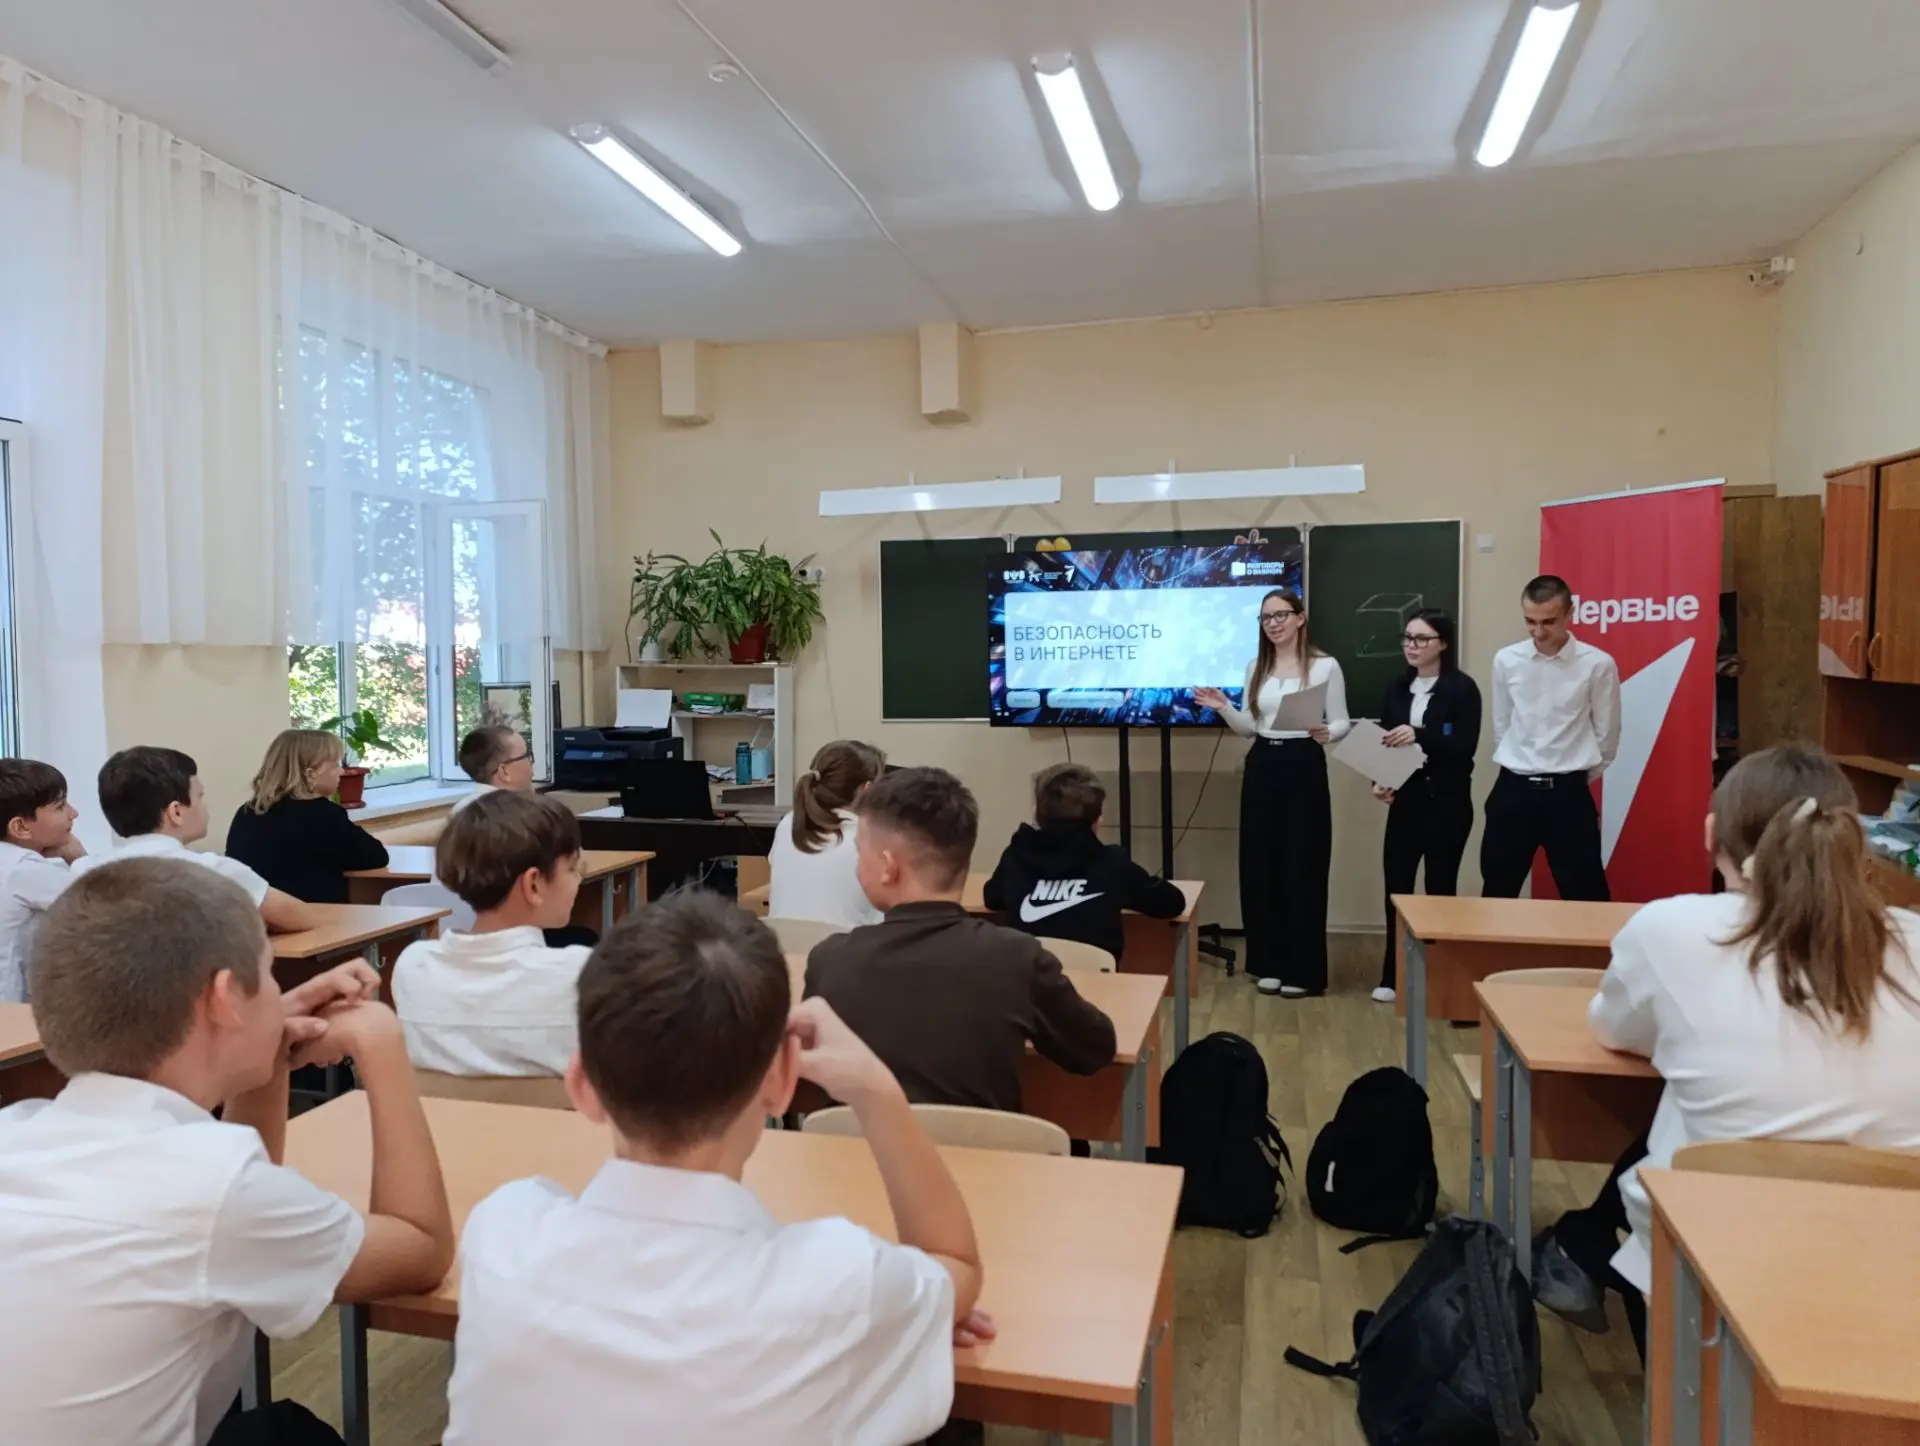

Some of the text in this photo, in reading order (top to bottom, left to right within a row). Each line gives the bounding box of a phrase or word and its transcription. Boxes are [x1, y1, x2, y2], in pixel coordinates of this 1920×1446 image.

[1013, 624, 1162, 641] БЕЗОПАСНОСТЬ
[1014, 645, 1137, 661] В ИНТЕРНЕТЕ
[1031, 879, 1088, 900] NIKE
